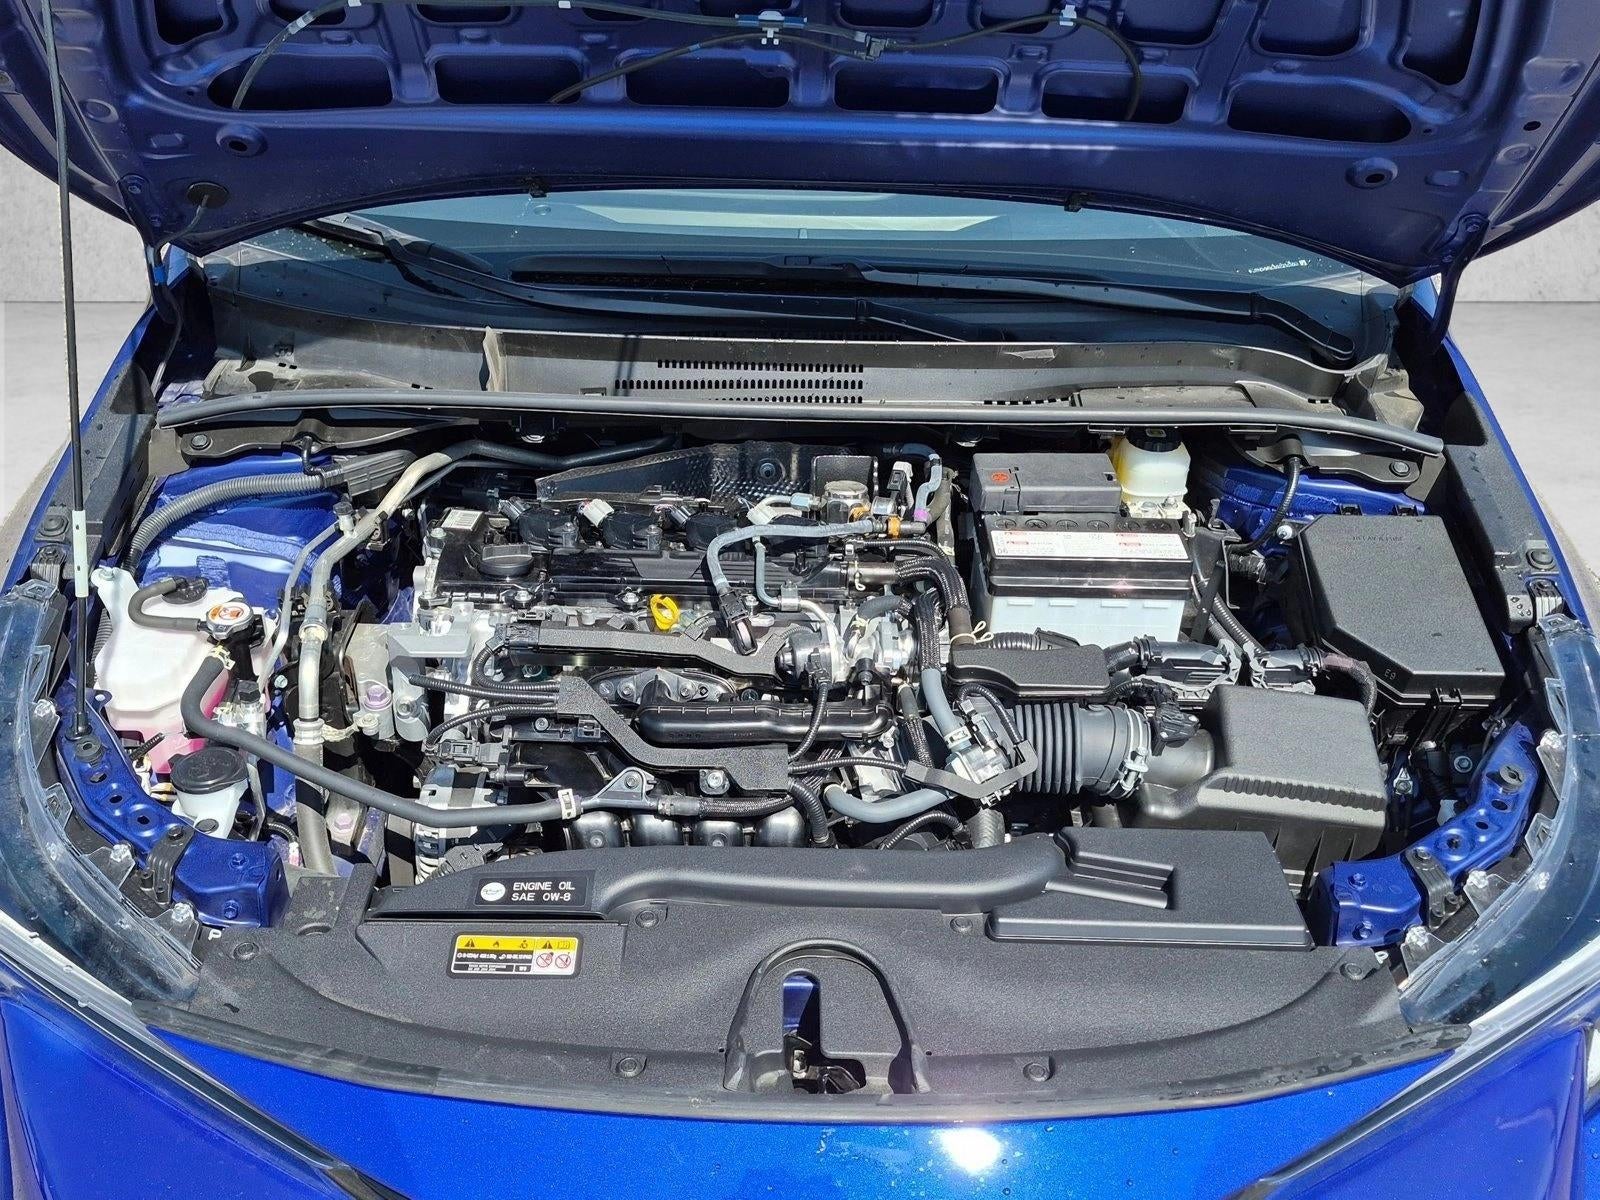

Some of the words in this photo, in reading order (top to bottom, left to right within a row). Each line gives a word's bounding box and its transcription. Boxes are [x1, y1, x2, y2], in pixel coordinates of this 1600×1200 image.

[512, 881, 552, 891] ENGINE
[558, 881, 575, 891] OIL
[511, 892, 535, 901] SAE
[542, 892, 571, 901] 0W-8
